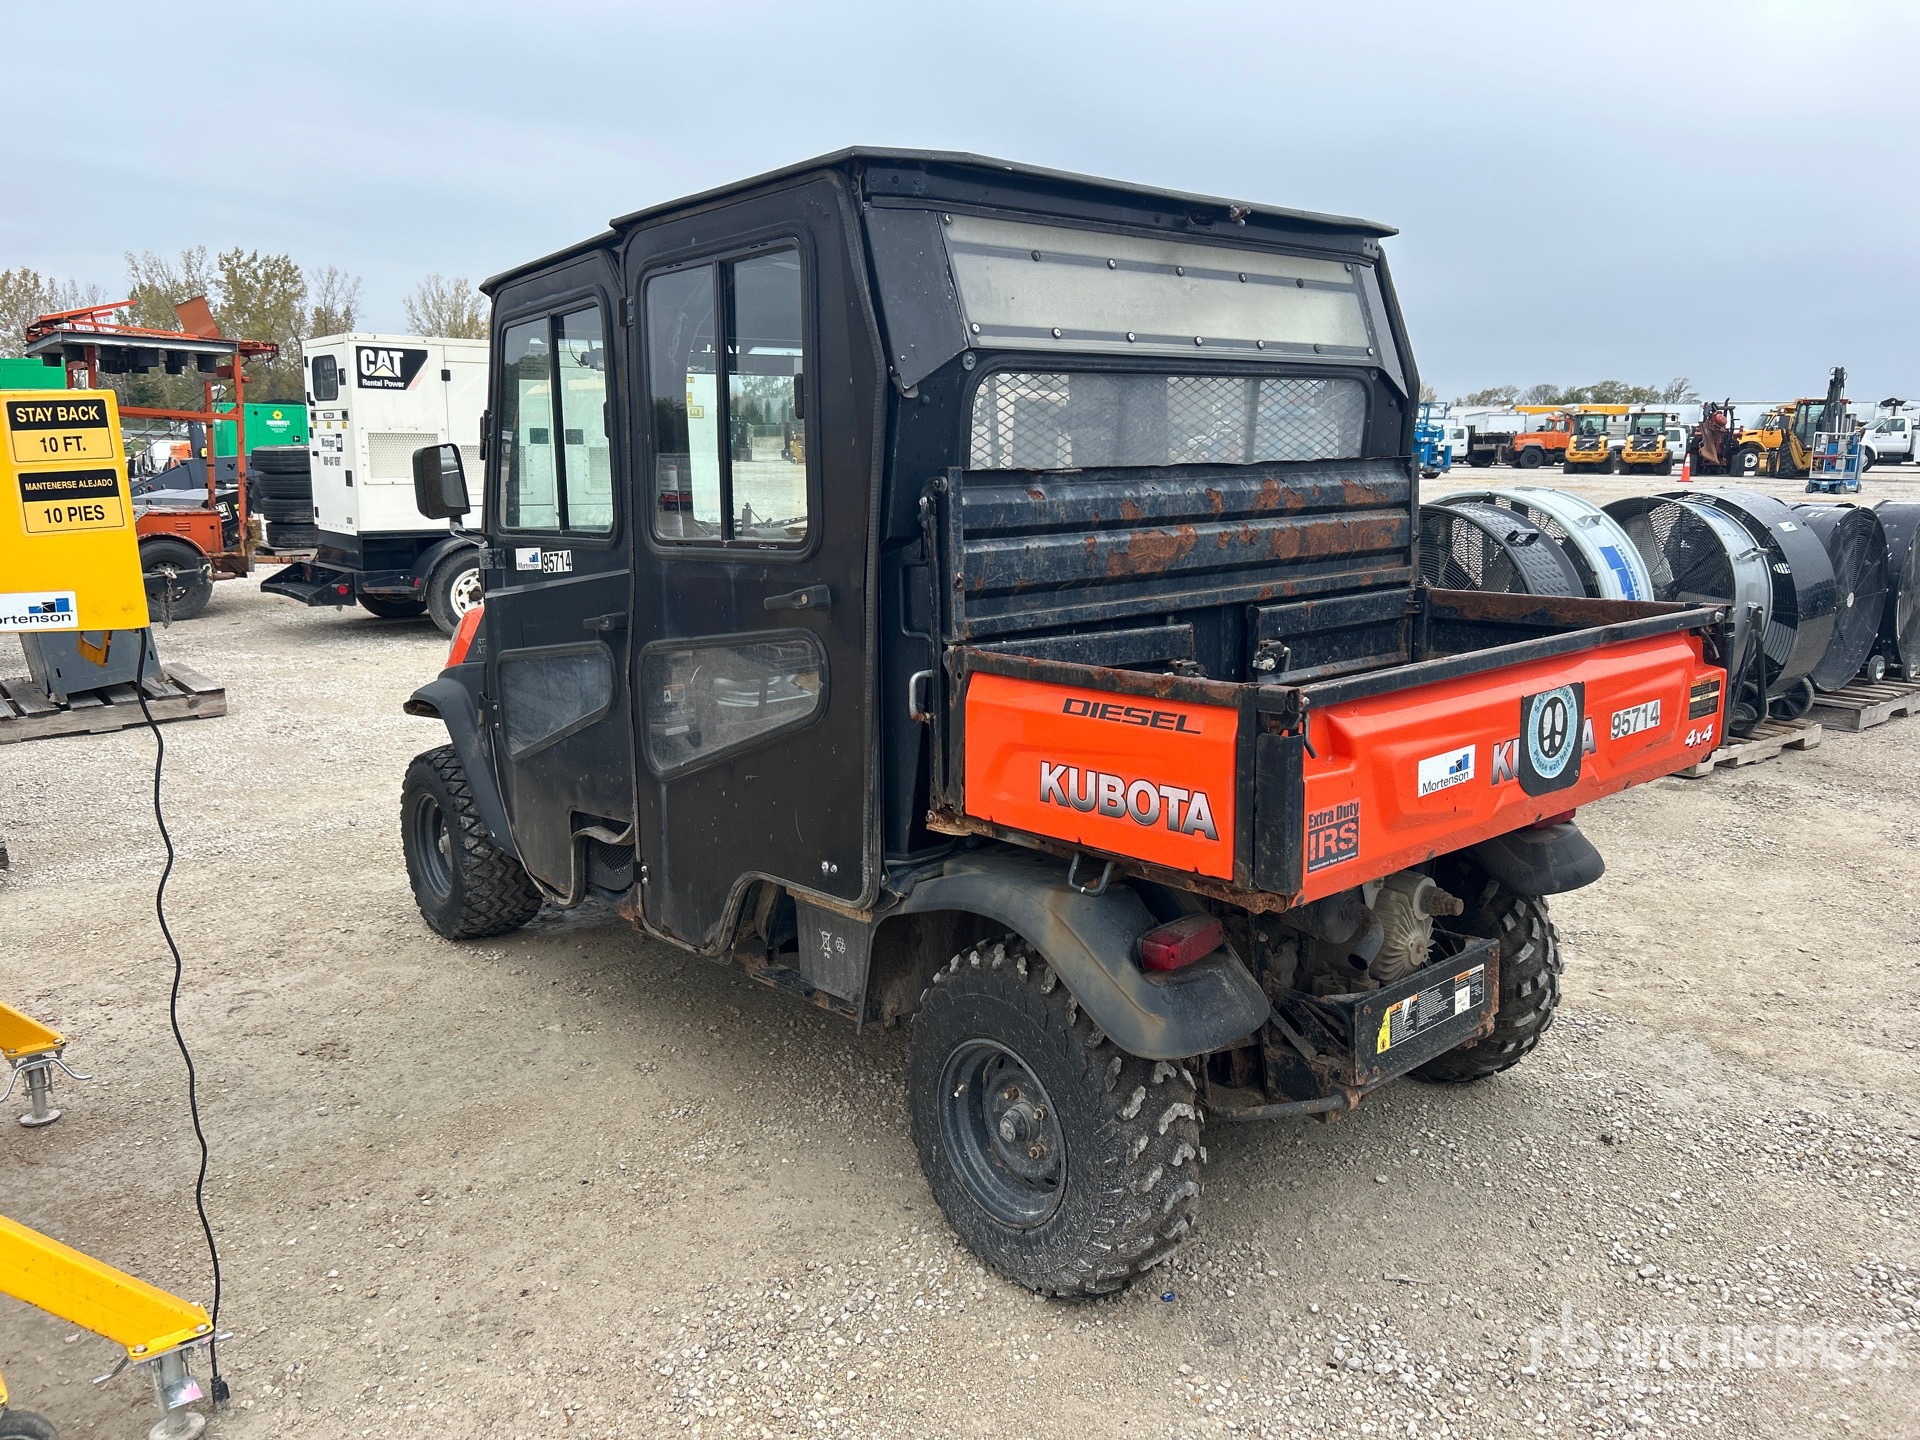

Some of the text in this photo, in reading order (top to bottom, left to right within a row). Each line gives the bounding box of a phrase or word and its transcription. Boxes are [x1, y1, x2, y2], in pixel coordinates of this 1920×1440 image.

[360, 348, 404, 378] CAT
[362, 379, 405, 388] Rental Power
[16, 405, 100, 423] STAY BACK
[40, 436, 87, 453] 10 FT.
[25, 478, 113, 491] MANTENERSE ALEJADO
[44, 504, 105, 524] 10 PIES
[543, 552, 571, 572] 95714
[0, 613, 72, 625] rtenson
[1062, 697, 1201, 735] DIESEL
[1611, 701, 1660, 739] 95714
[1684, 723, 1714, 748] 4x4
[1422, 771, 1469, 794] Mortenson
[1039, 759, 1220, 842] KUBOTA
[1308, 801, 1360, 829] Extra Duty
[1309, 821, 1357, 862] IRS
